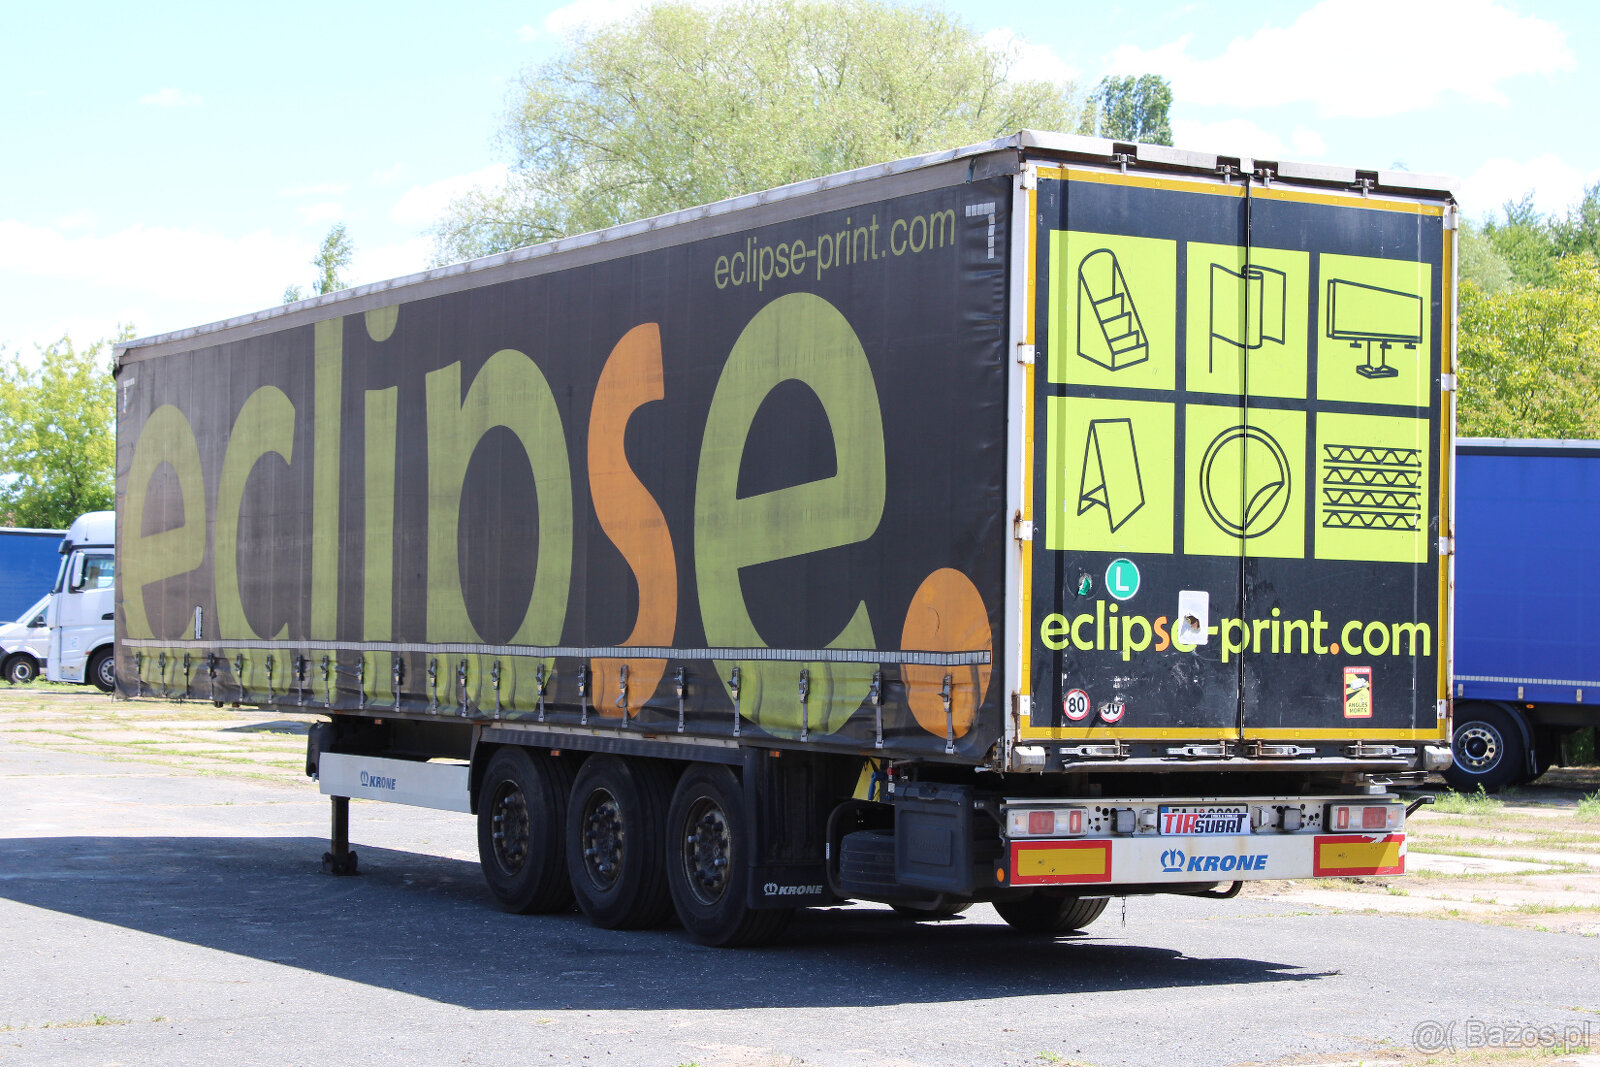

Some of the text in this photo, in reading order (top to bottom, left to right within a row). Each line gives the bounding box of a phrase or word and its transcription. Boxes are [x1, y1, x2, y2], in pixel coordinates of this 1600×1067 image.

[714, 208, 956, 291] eclipse-print.com
[1115, 566, 1130, 592] L
[1068, 696, 1085, 713] 80
[369, 775, 397, 790] KRONE
[1186, 854, 1269, 872] KRONE
[778, 885, 823, 895] KRONE
